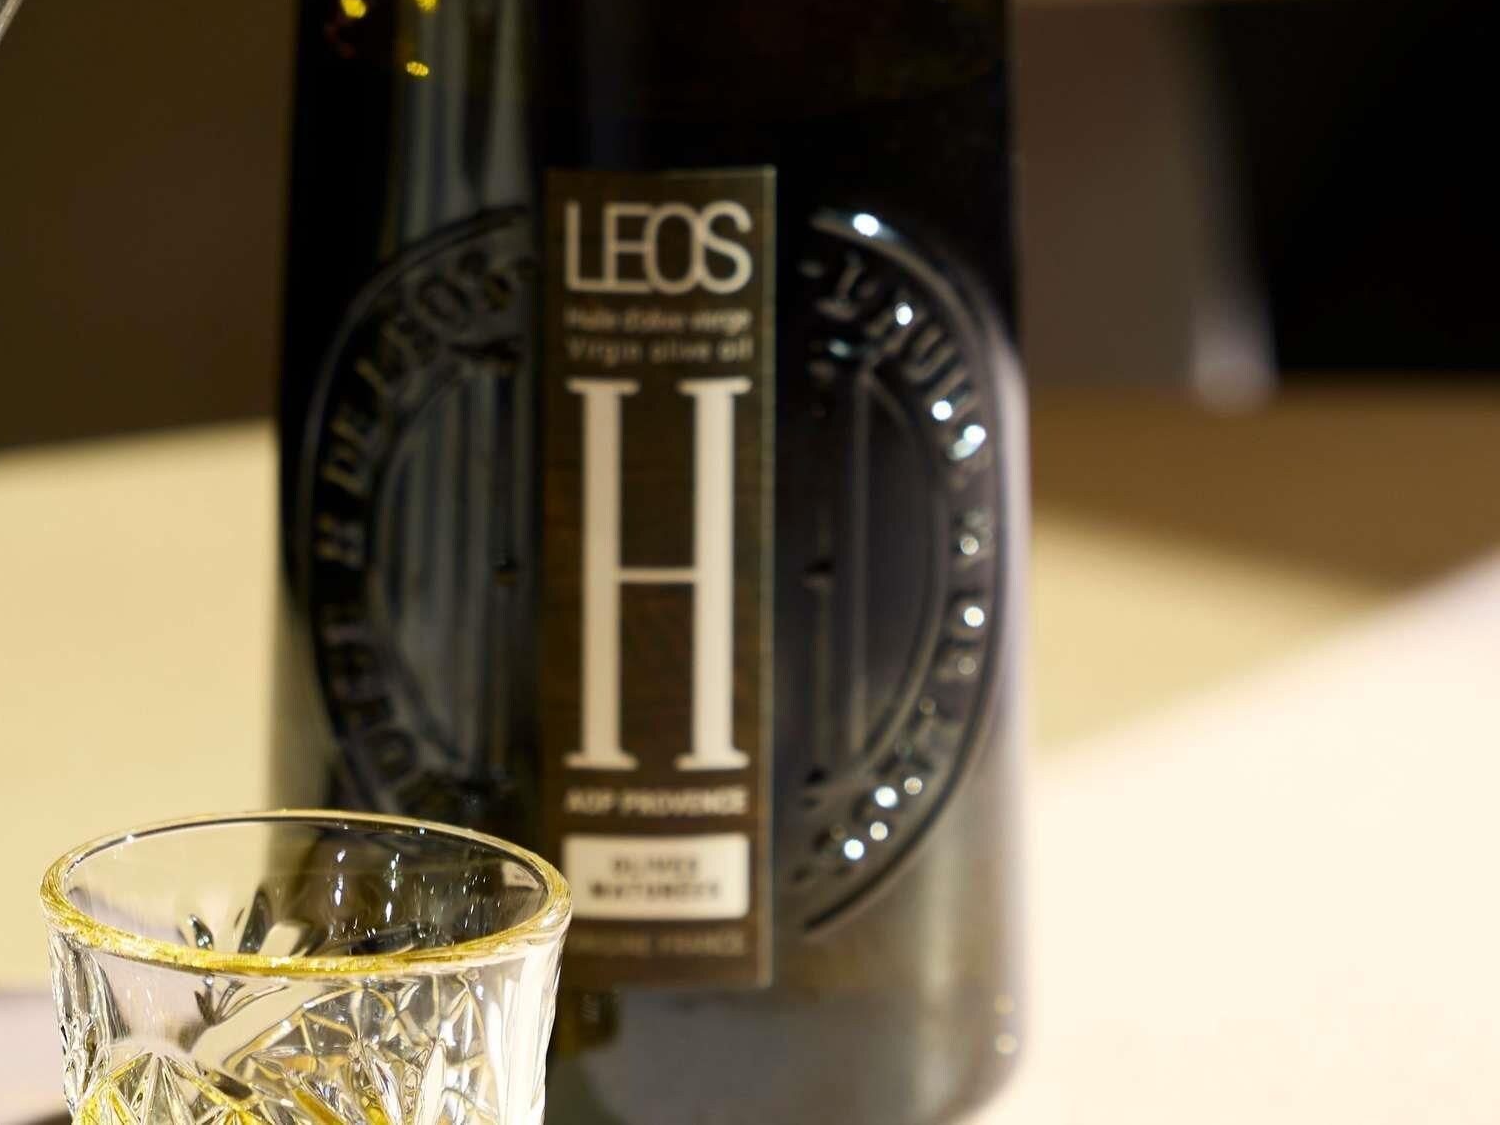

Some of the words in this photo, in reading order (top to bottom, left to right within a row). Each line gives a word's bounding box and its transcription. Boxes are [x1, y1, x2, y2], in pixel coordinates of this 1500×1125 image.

[565, 200, 752, 294] LEOS
[566, 337, 642, 366] Virgin
[649, 338, 711, 364] olive
[716, 335, 754, 362] oil
[565, 377, 751, 770] H
[619, 784, 748, 817] PROVENCE
